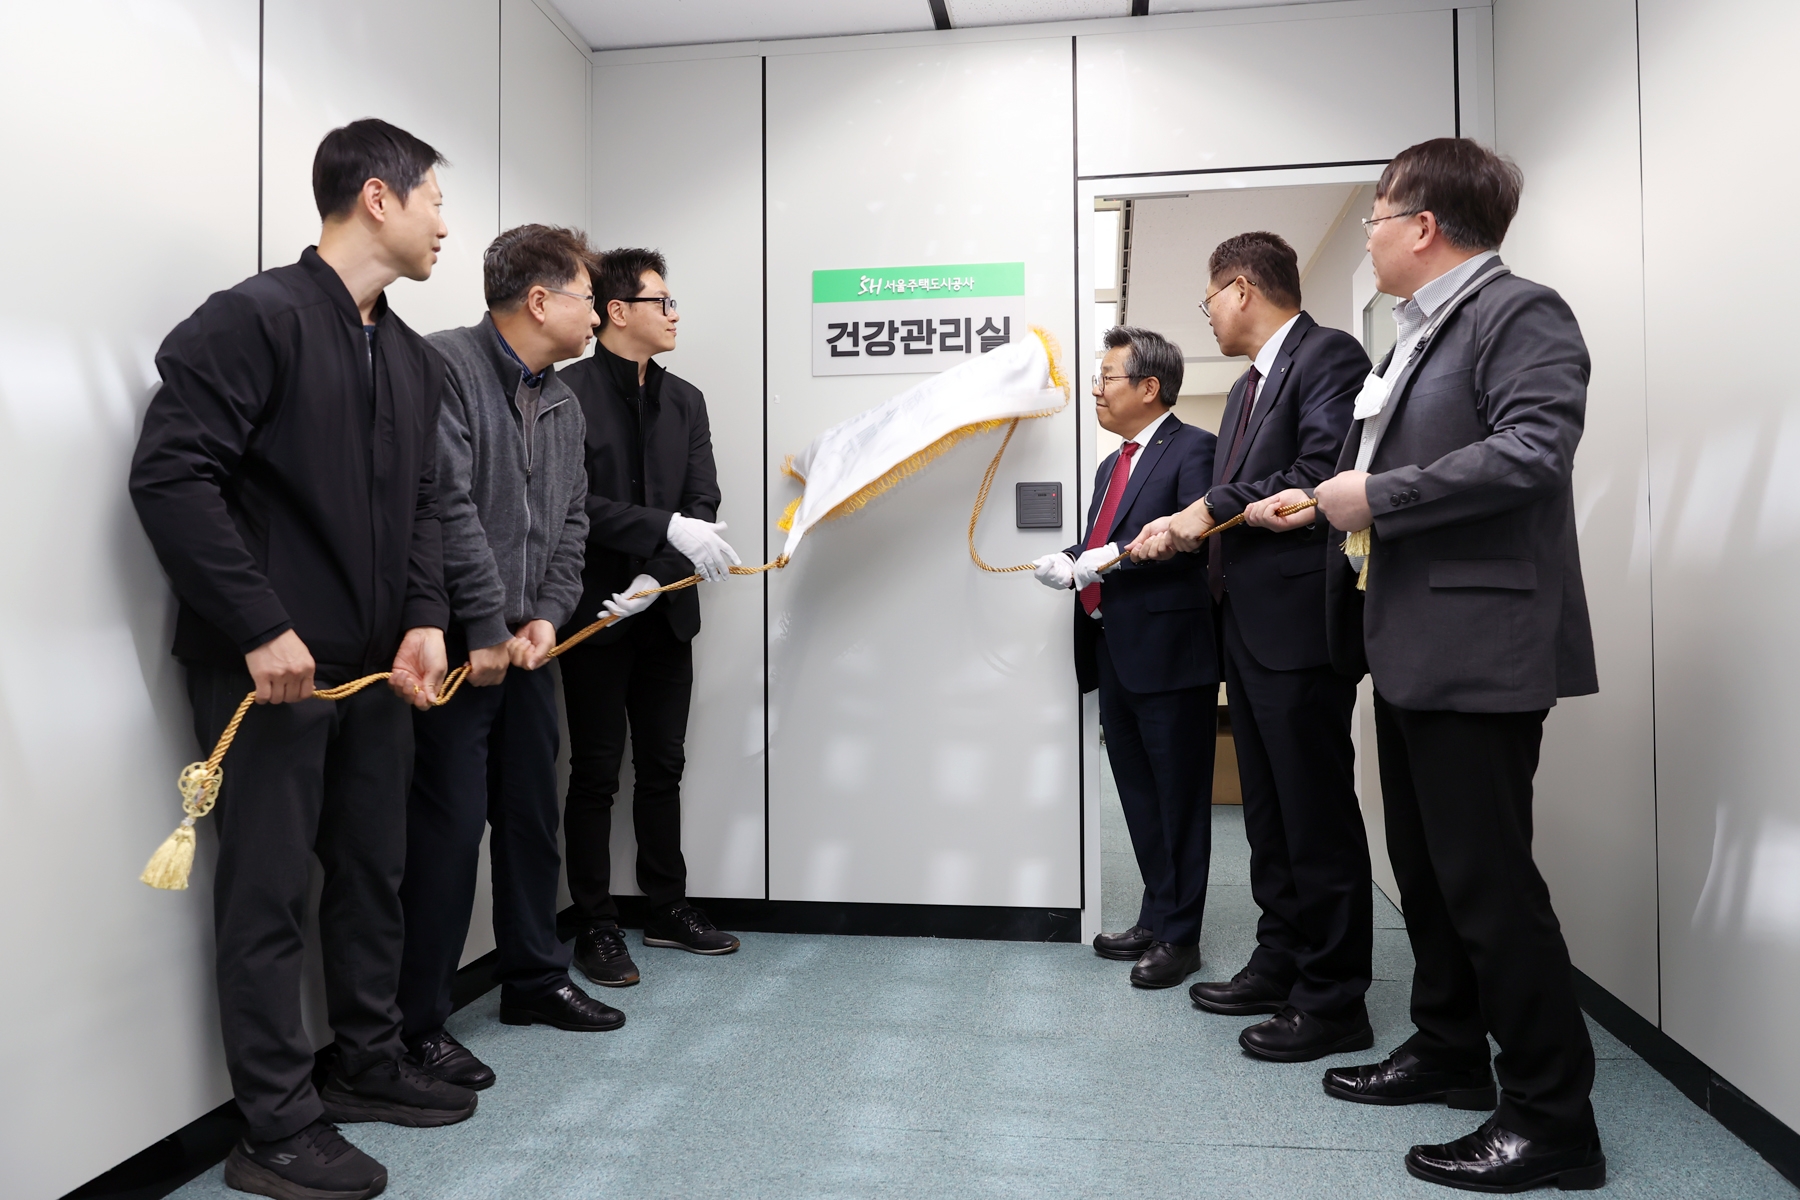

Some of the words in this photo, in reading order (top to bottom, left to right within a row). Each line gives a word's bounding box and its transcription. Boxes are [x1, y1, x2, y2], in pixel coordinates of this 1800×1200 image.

[858, 275, 883, 295] SH
[884, 277, 975, 293] 서울주택도시공사
[826, 316, 1010, 357] 건강관리실
